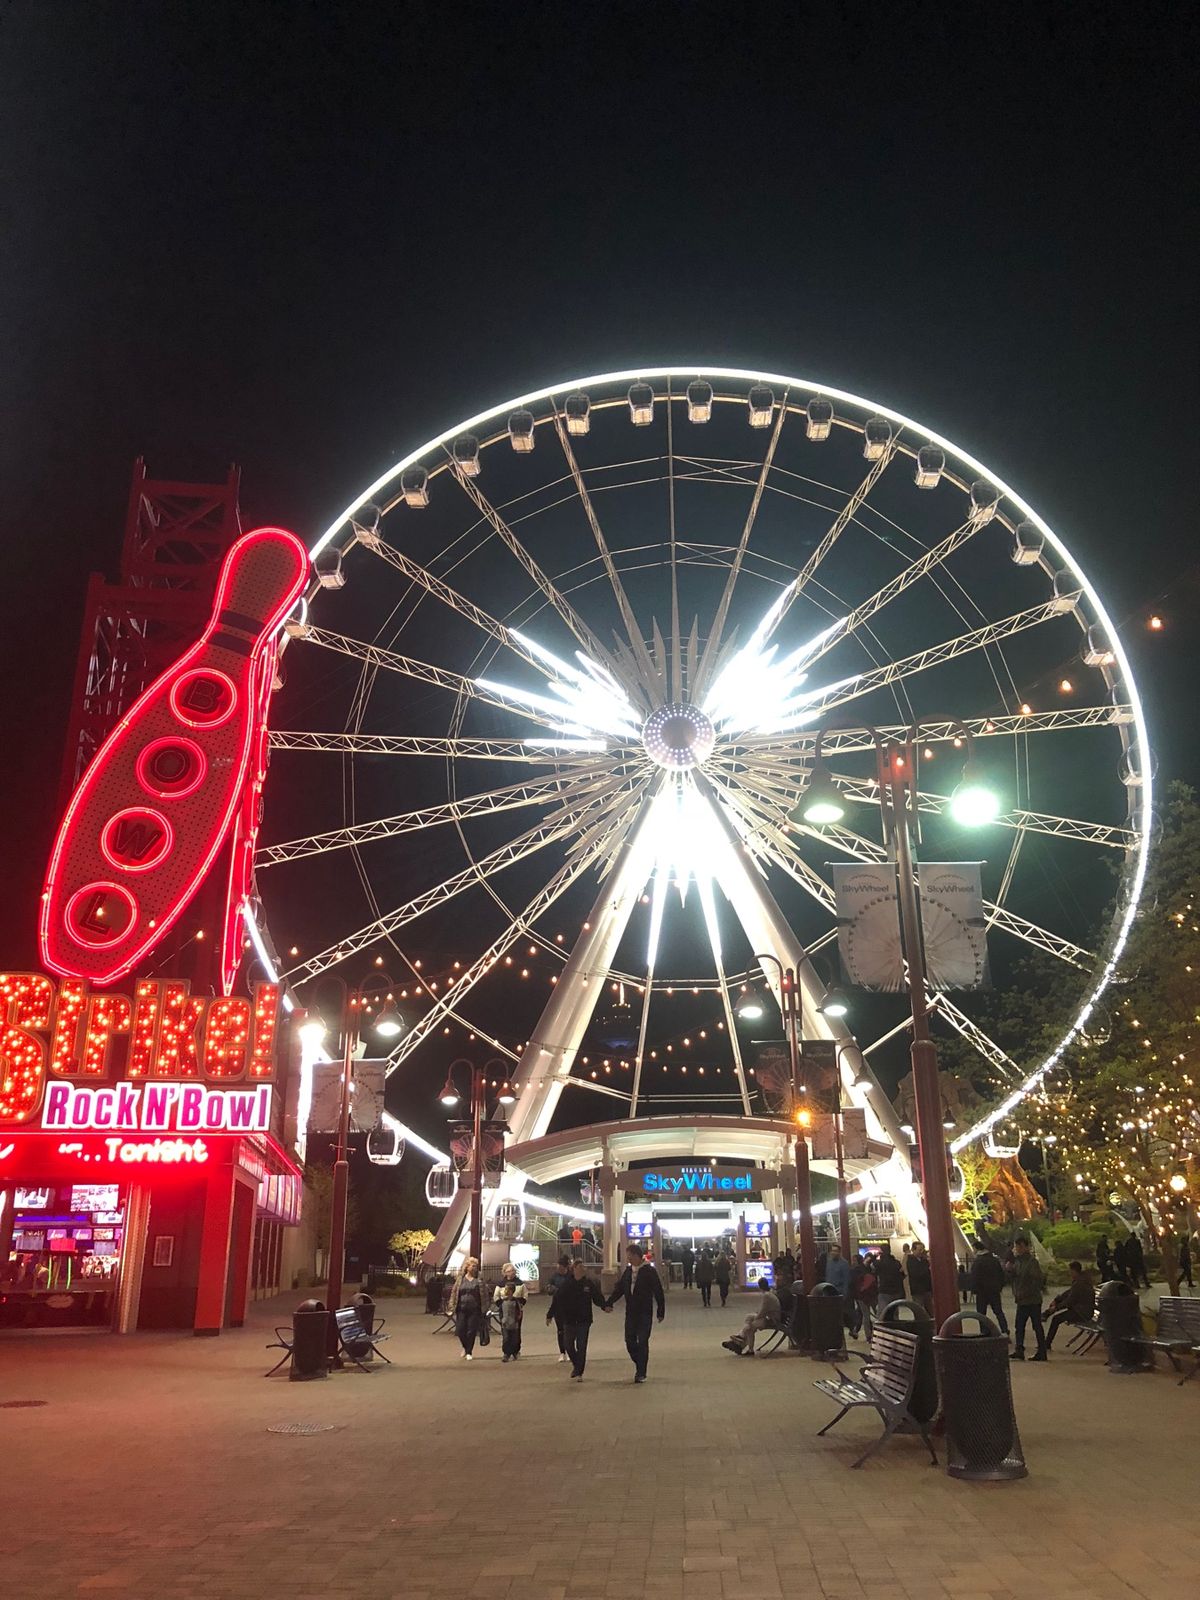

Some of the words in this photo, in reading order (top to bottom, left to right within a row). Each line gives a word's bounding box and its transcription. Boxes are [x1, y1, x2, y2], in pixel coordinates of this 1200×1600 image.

[842, 885, 889, 893] SkyWheel
[927, 884, 974, 893] SkyWheel
[643, 1172, 752, 1193] SkyWheel
